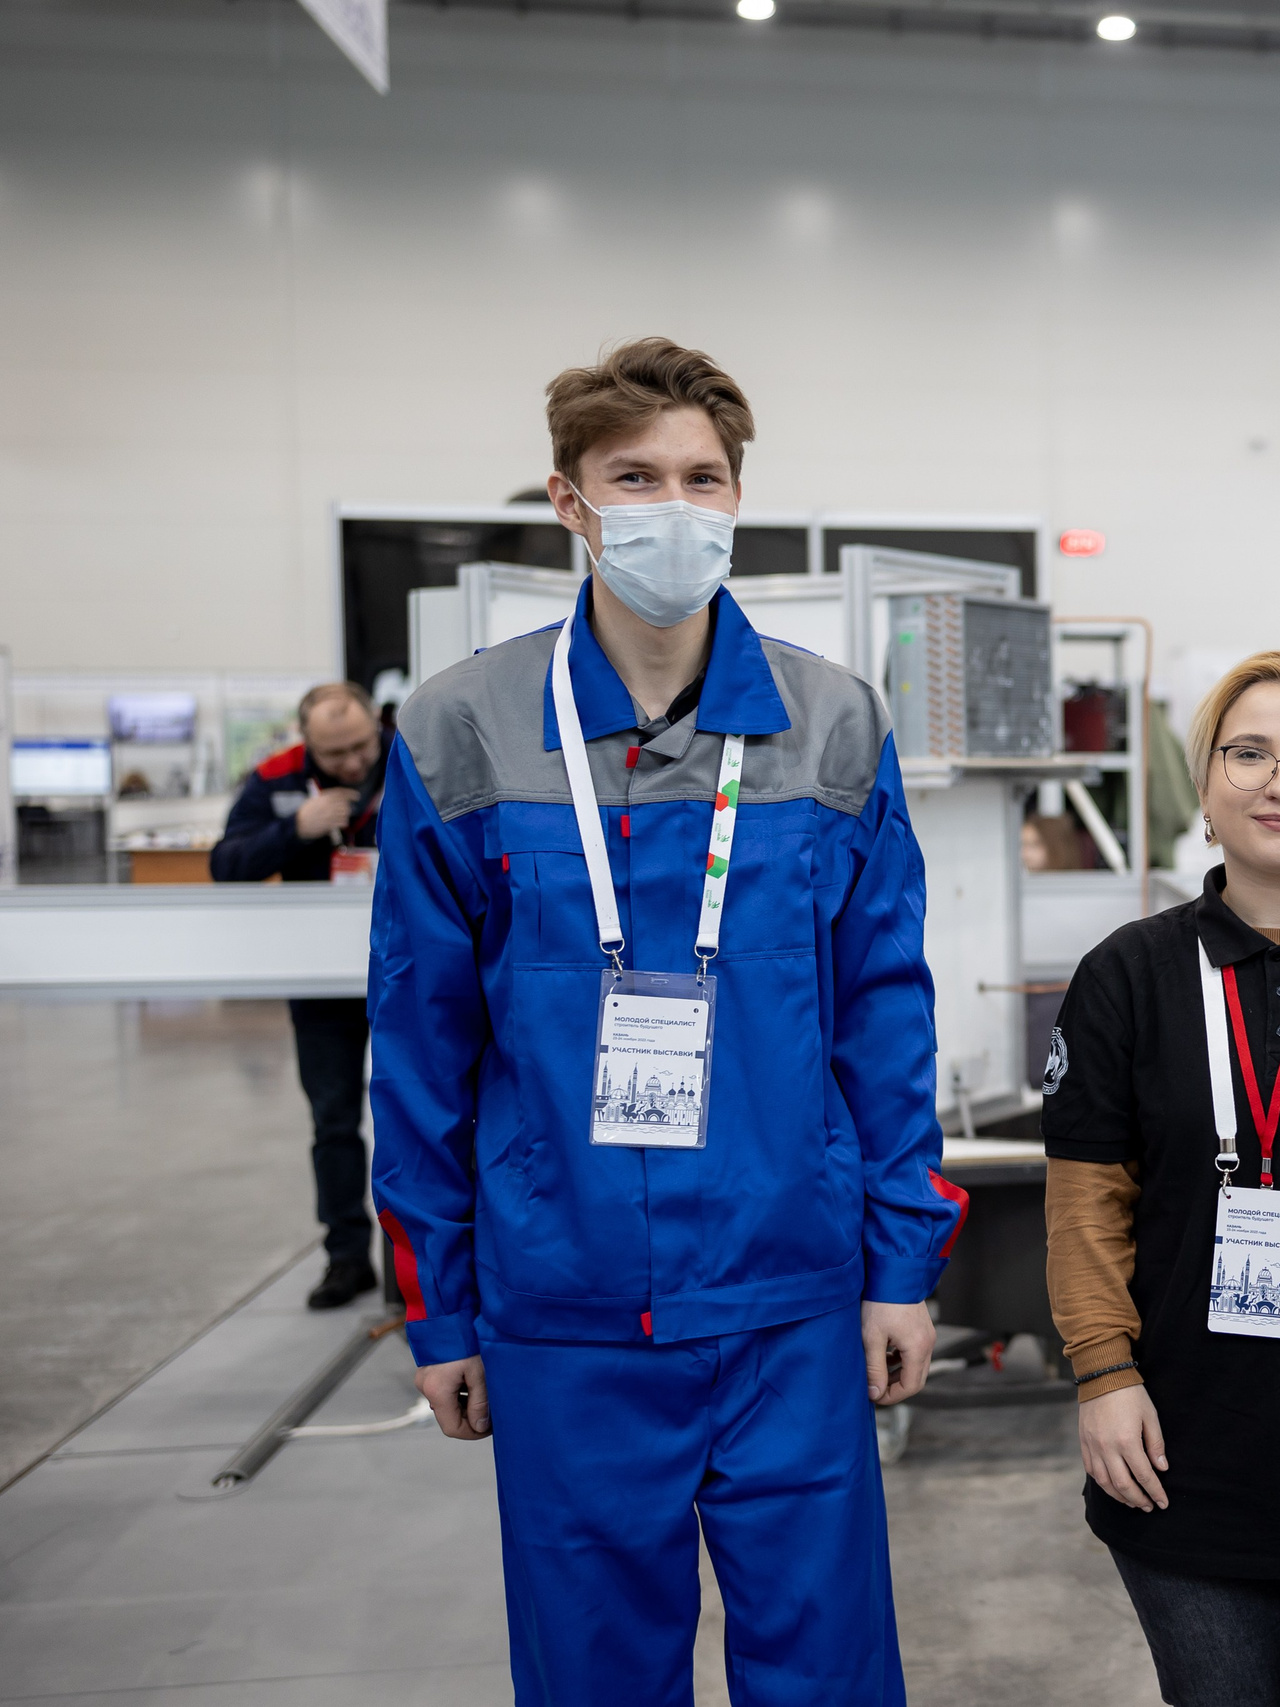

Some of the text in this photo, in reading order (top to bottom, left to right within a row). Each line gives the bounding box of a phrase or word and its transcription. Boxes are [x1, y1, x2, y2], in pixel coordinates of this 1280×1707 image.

[614, 1016, 697, 1027] МОЛОДОЙ СПЕЦИАЛИСТ
[611, 1046, 694, 1057] УЧАСТНИК ВЫСТАВКИ
[1227, 1208, 1261, 1216] МОЛОДОЙ
[1225, 1238, 1263, 1247] УЧАСТНИК
